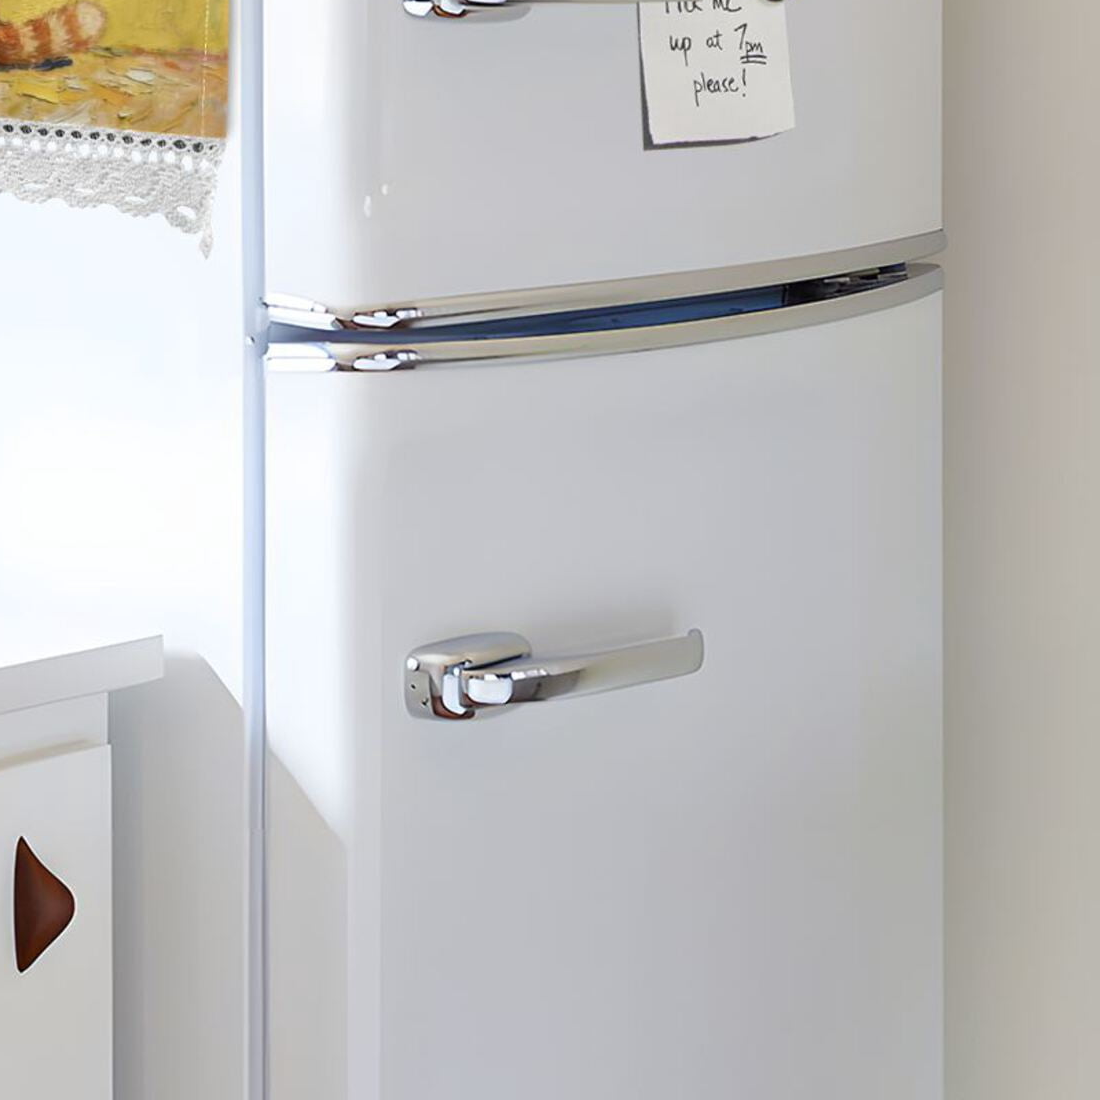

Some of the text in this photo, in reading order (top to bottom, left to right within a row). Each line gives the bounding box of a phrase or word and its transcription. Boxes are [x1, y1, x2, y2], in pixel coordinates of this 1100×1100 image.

[669, 35, 692, 67] up
[706, 29, 723, 51] at
[693, 68, 747, 107] please!
